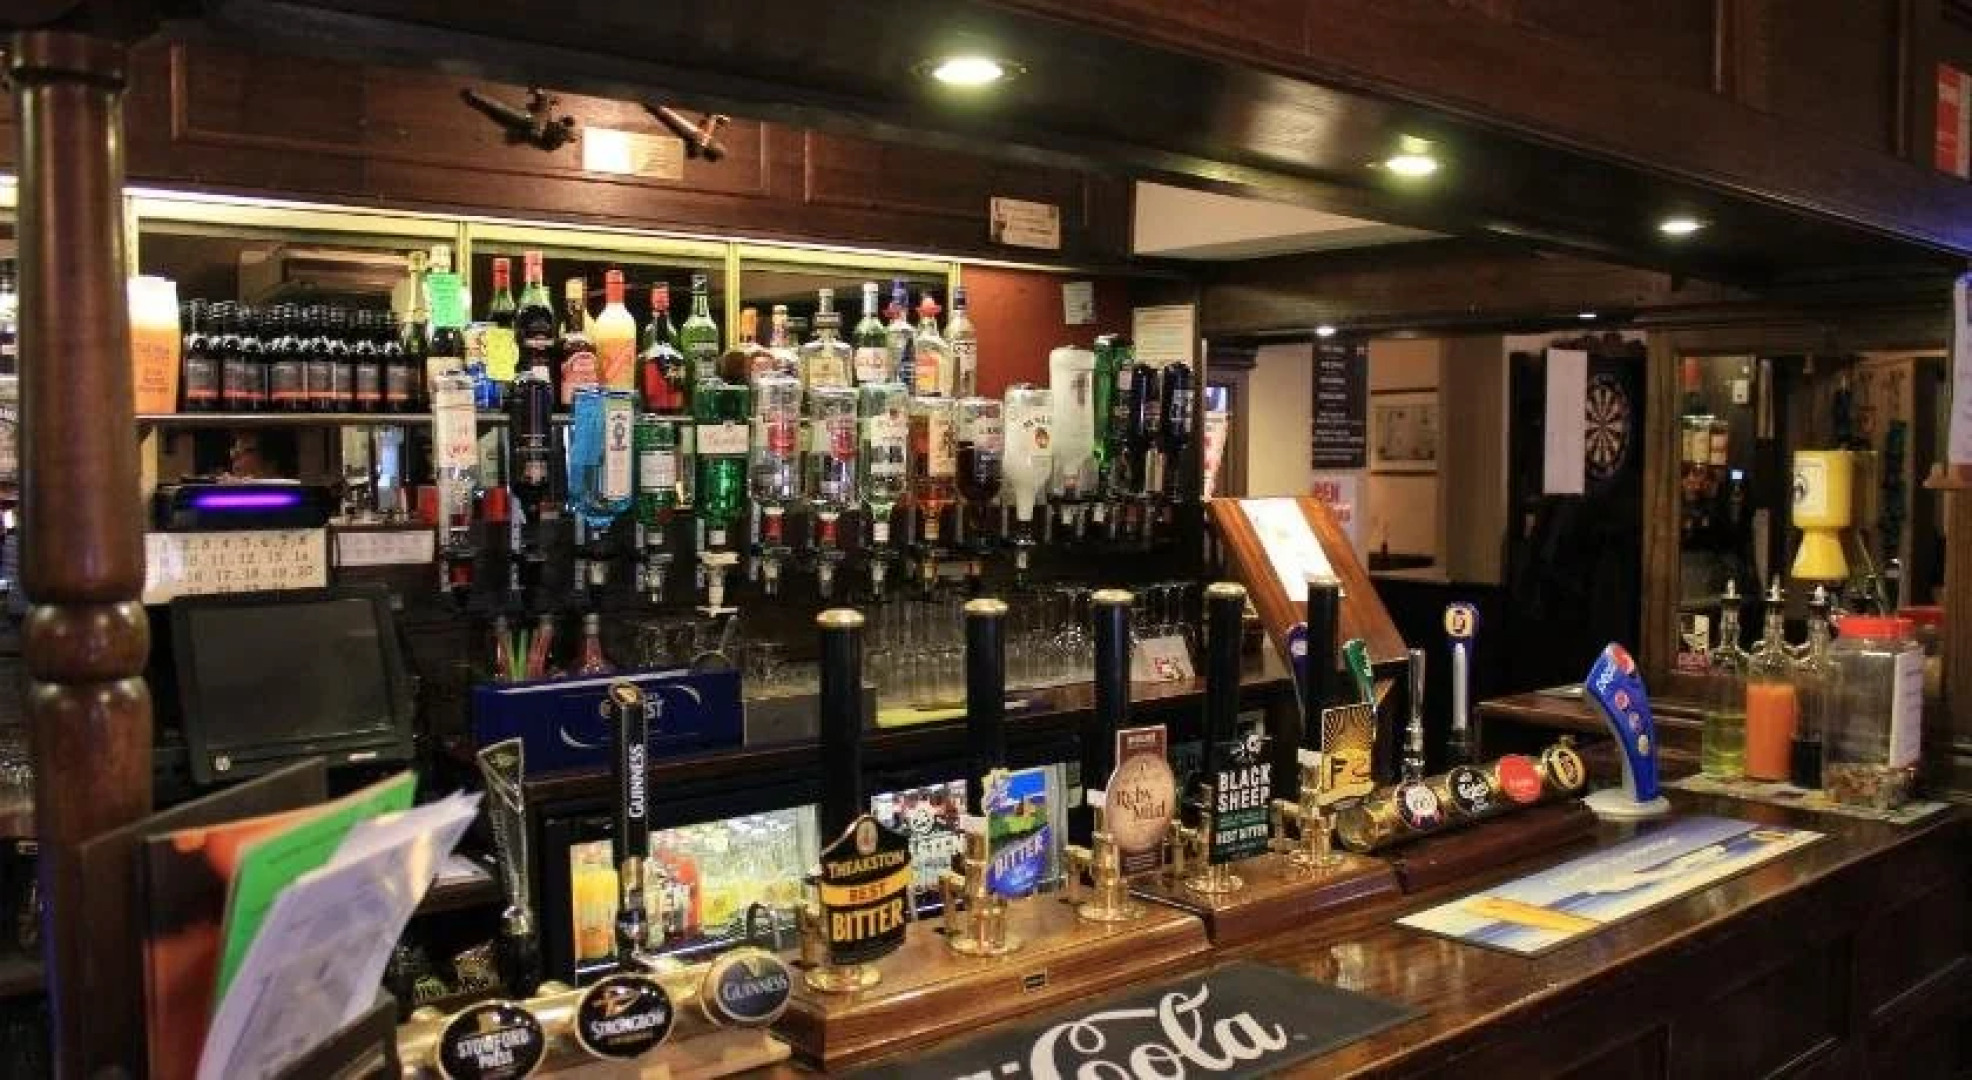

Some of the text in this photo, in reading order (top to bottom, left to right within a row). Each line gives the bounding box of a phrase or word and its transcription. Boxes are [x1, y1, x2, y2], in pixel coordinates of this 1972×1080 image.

[629, 743, 644, 818] GUINNESS
[1217, 763, 1271, 792] BLACK
[1116, 785, 1152, 811] Ruby
[1132, 800, 1165, 820] Mild
[1217, 786, 1271, 813] SHEEP
[1215, 824, 1269, 845] BEST BITTER
[826, 849, 905, 879] THEAKSTON
[995, 833, 1045, 880] BITTER
[848, 882, 886, 901] BEST
[832, 897, 905, 942] BITTER
[722, 974, 789, 1002] GUINNESS
[590, 1009, 667, 1041] STRONGBOW
[456, 1025, 532, 1058] STOWFORD
[477, 1049, 515, 1070] PRESS
